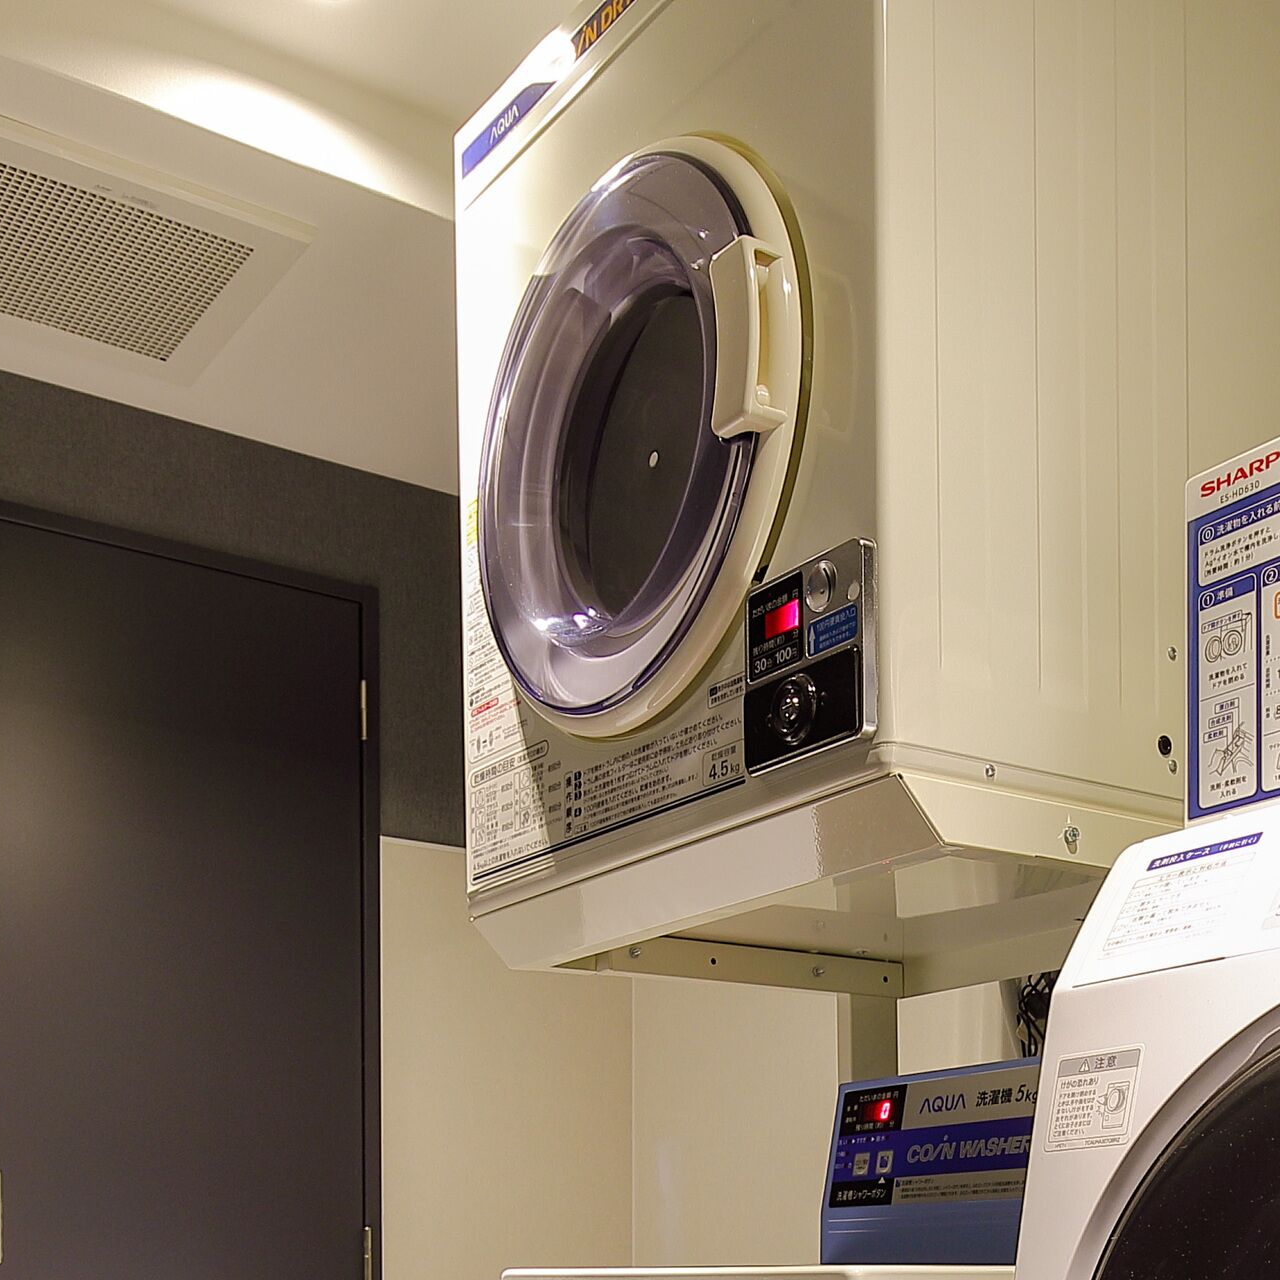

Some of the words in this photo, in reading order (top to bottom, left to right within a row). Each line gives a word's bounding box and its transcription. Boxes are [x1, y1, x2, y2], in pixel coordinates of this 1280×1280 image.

[488, 104, 519, 144] AQUA
[1200, 451, 1280, 498] SHARP
[1152, 848, 1210, 868] 洗剤投入ケース
[1094, 1055, 1117, 1070] 注意
[1060, 1077, 1099, 1089] けがの恐れあり
[880, 1103, 890, 1119] 0
[919, 1093, 966, 1115] AQUA
[976, 1088, 1012, 1107] 洗濯機
